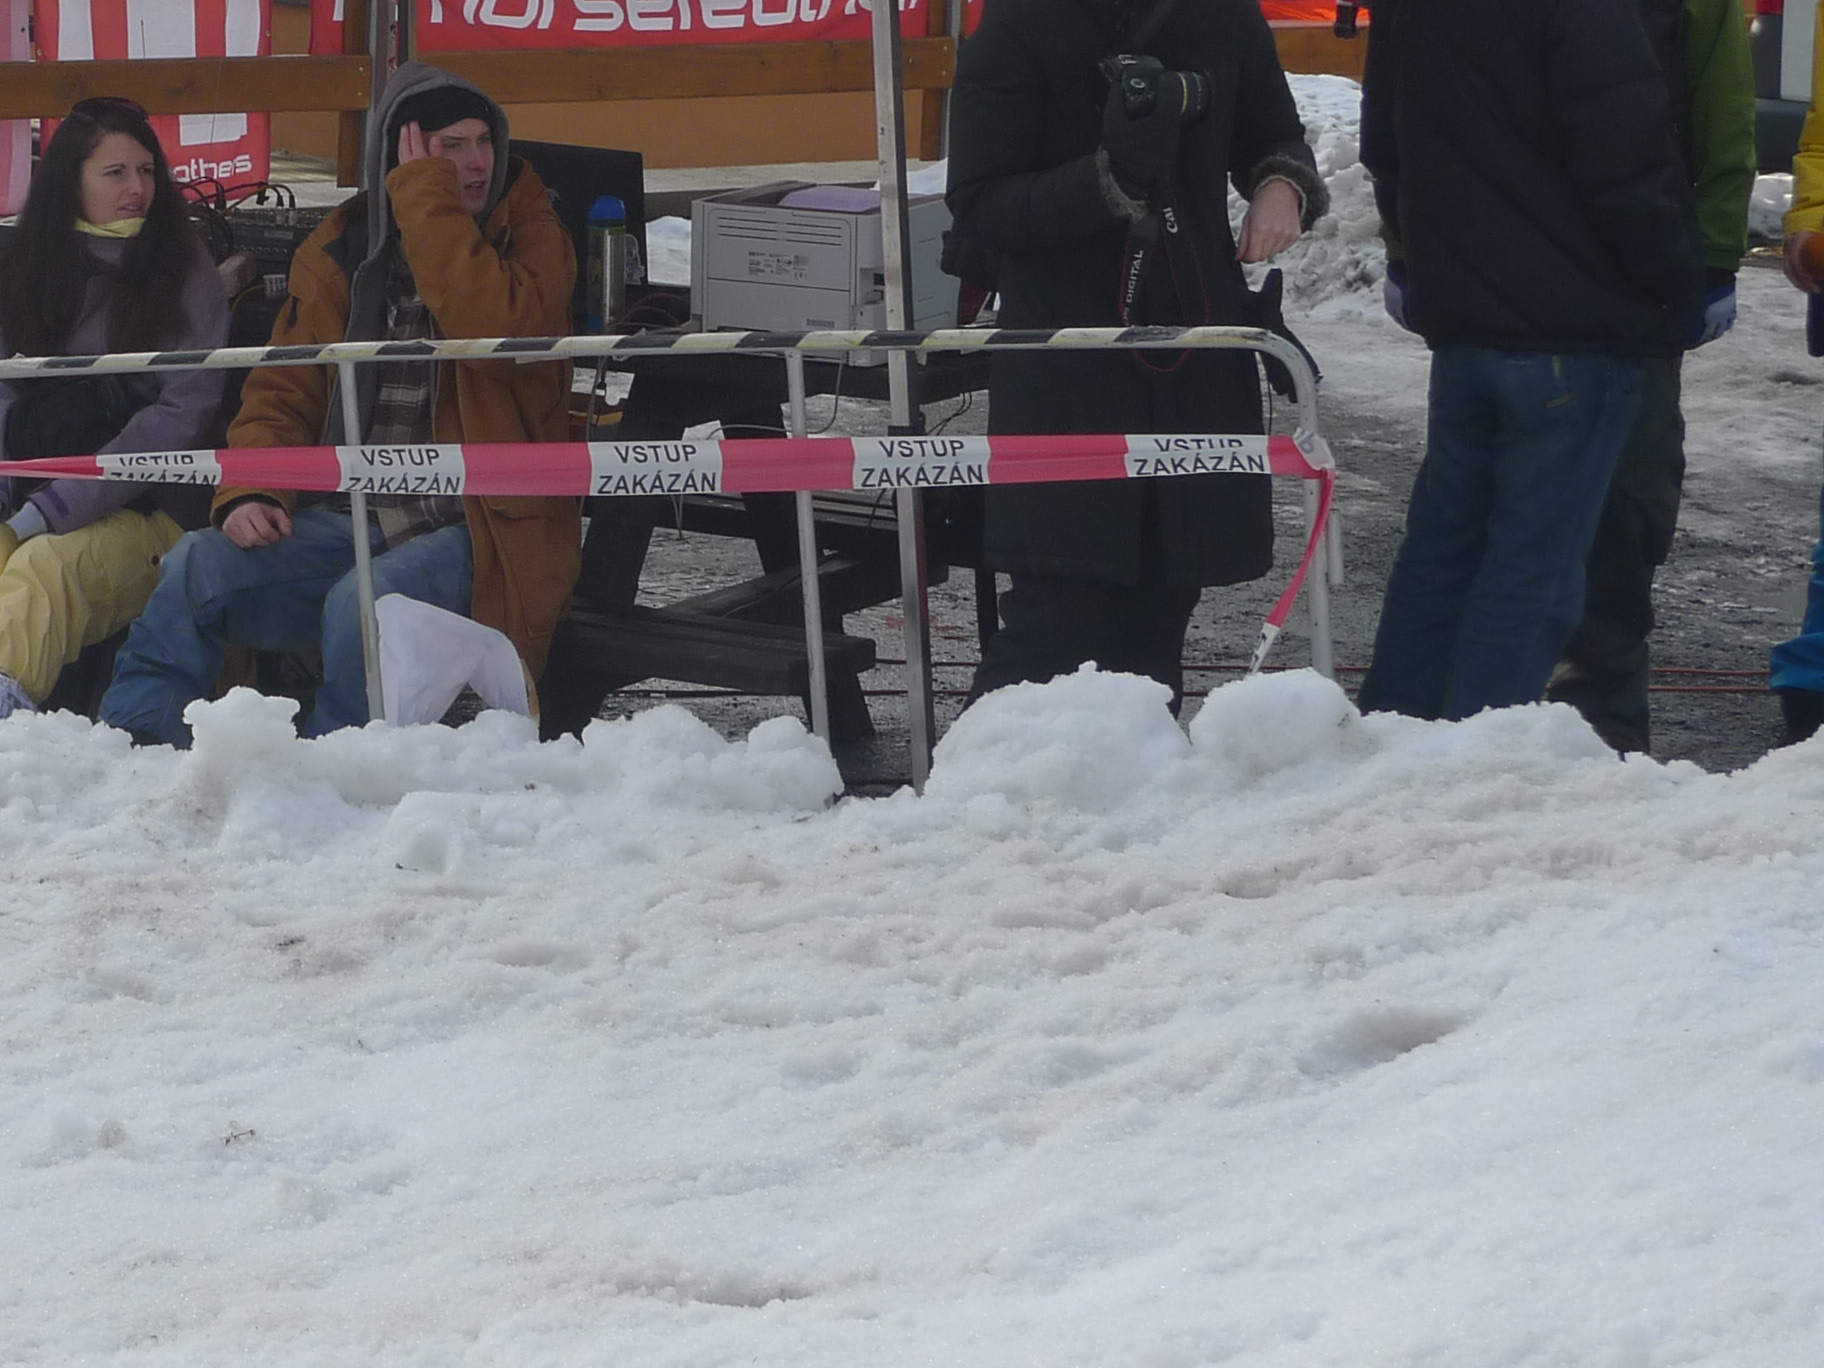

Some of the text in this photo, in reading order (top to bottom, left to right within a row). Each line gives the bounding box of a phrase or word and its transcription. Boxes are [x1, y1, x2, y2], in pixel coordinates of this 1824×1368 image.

[361, 448, 441, 467] VSTUP
[613, 444, 697, 464] VSTUP
[878, 439, 965, 458] VSTUP
[860, 462, 985, 488] ZAKÁZÁN
[1132, 451, 1265, 476] ZAKÁZÁN
[344, 472, 462, 495] ZAKÁZÁN
[597, 469, 717, 495] ZAKÁZÁN
